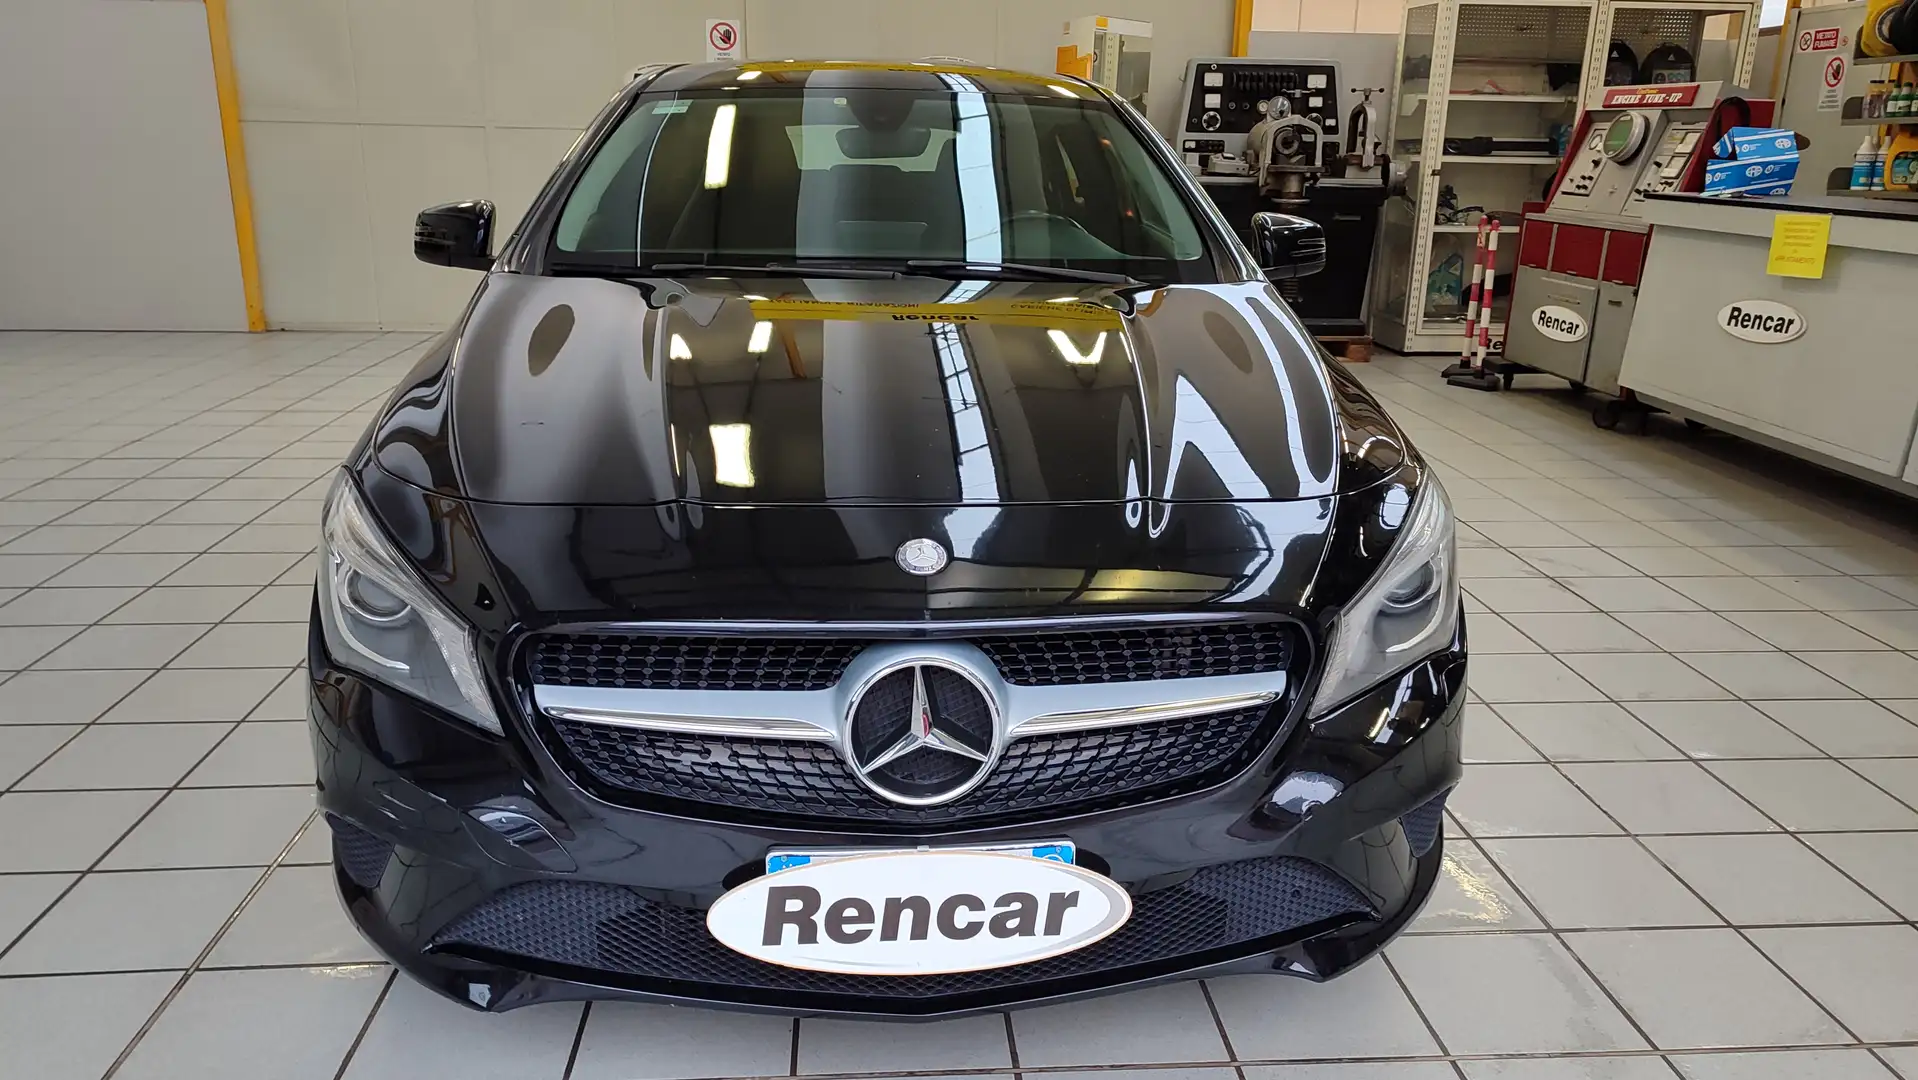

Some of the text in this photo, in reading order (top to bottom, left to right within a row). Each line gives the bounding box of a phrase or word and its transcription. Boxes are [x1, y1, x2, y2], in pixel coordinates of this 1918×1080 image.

[1610, 92, 1683, 105] ENGINE TUNE-UP
[1537, 309, 1580, 337] Rencar
[1726, 306, 1795, 335] Rencar
[761, 884, 1080, 947] Rencar
